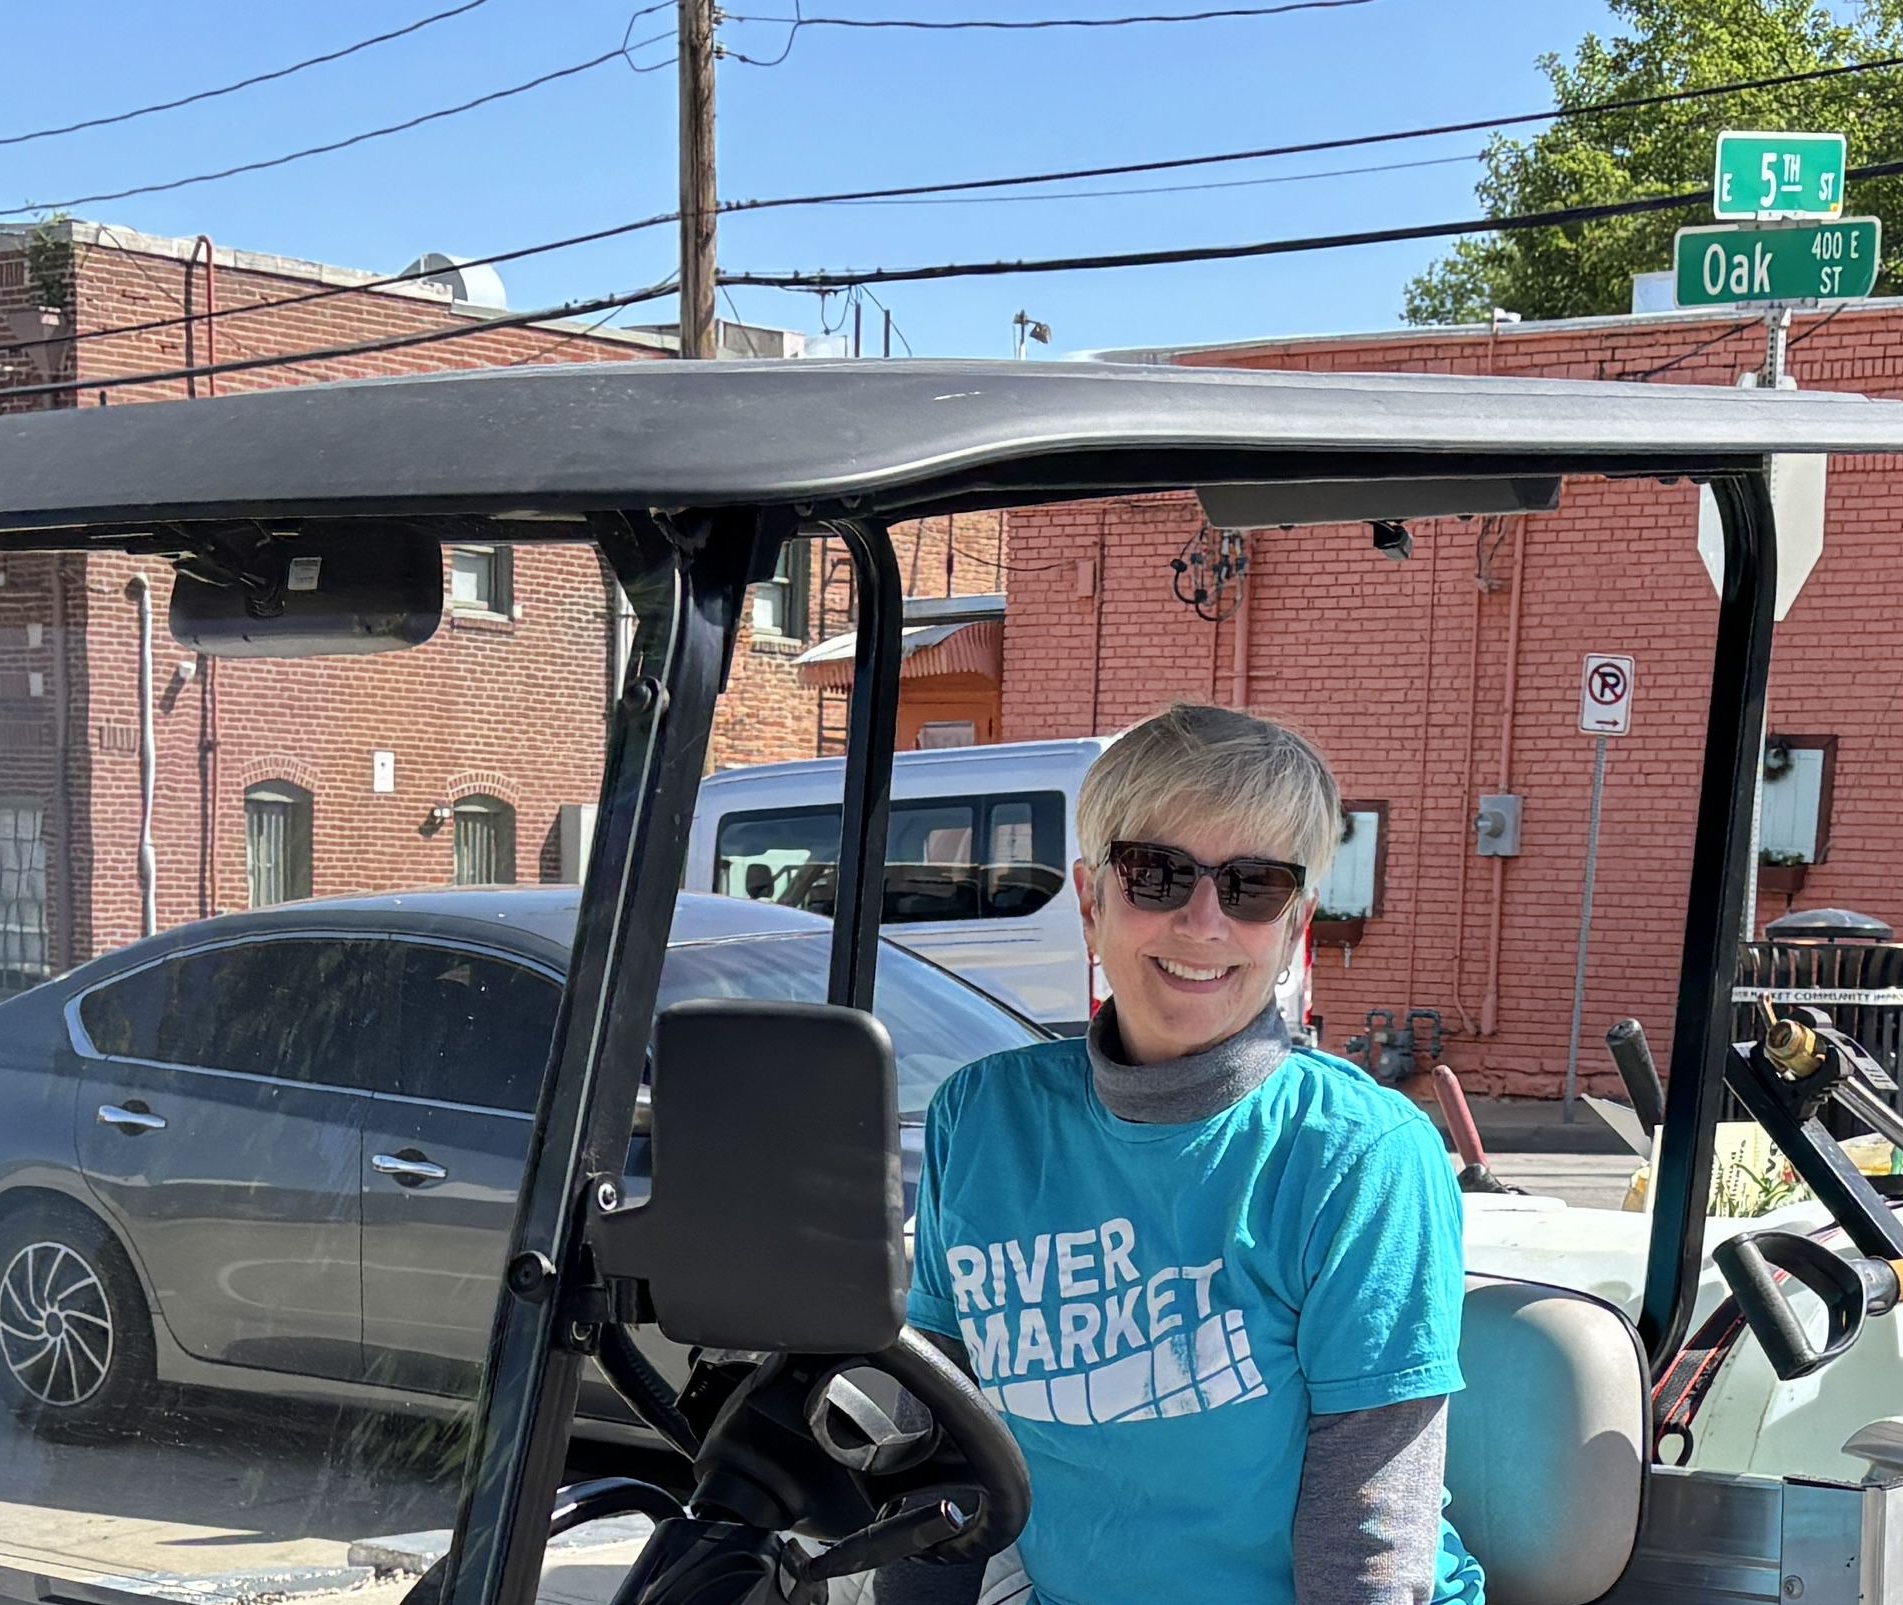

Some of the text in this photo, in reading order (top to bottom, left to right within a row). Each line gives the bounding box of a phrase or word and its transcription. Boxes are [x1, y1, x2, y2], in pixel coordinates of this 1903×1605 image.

[1722, 152, 1836, 207] E 5TH ST
[1703, 242, 1773, 296] Oak
[1811, 231, 1859, 260] 400 E
[1819, 266, 1843, 295] ST
[1794, 991, 1870, 1002] COMMUNITY
[946, 1216, 1141, 1314] RIVER
[959, 1257, 1224, 1381] MARKET
